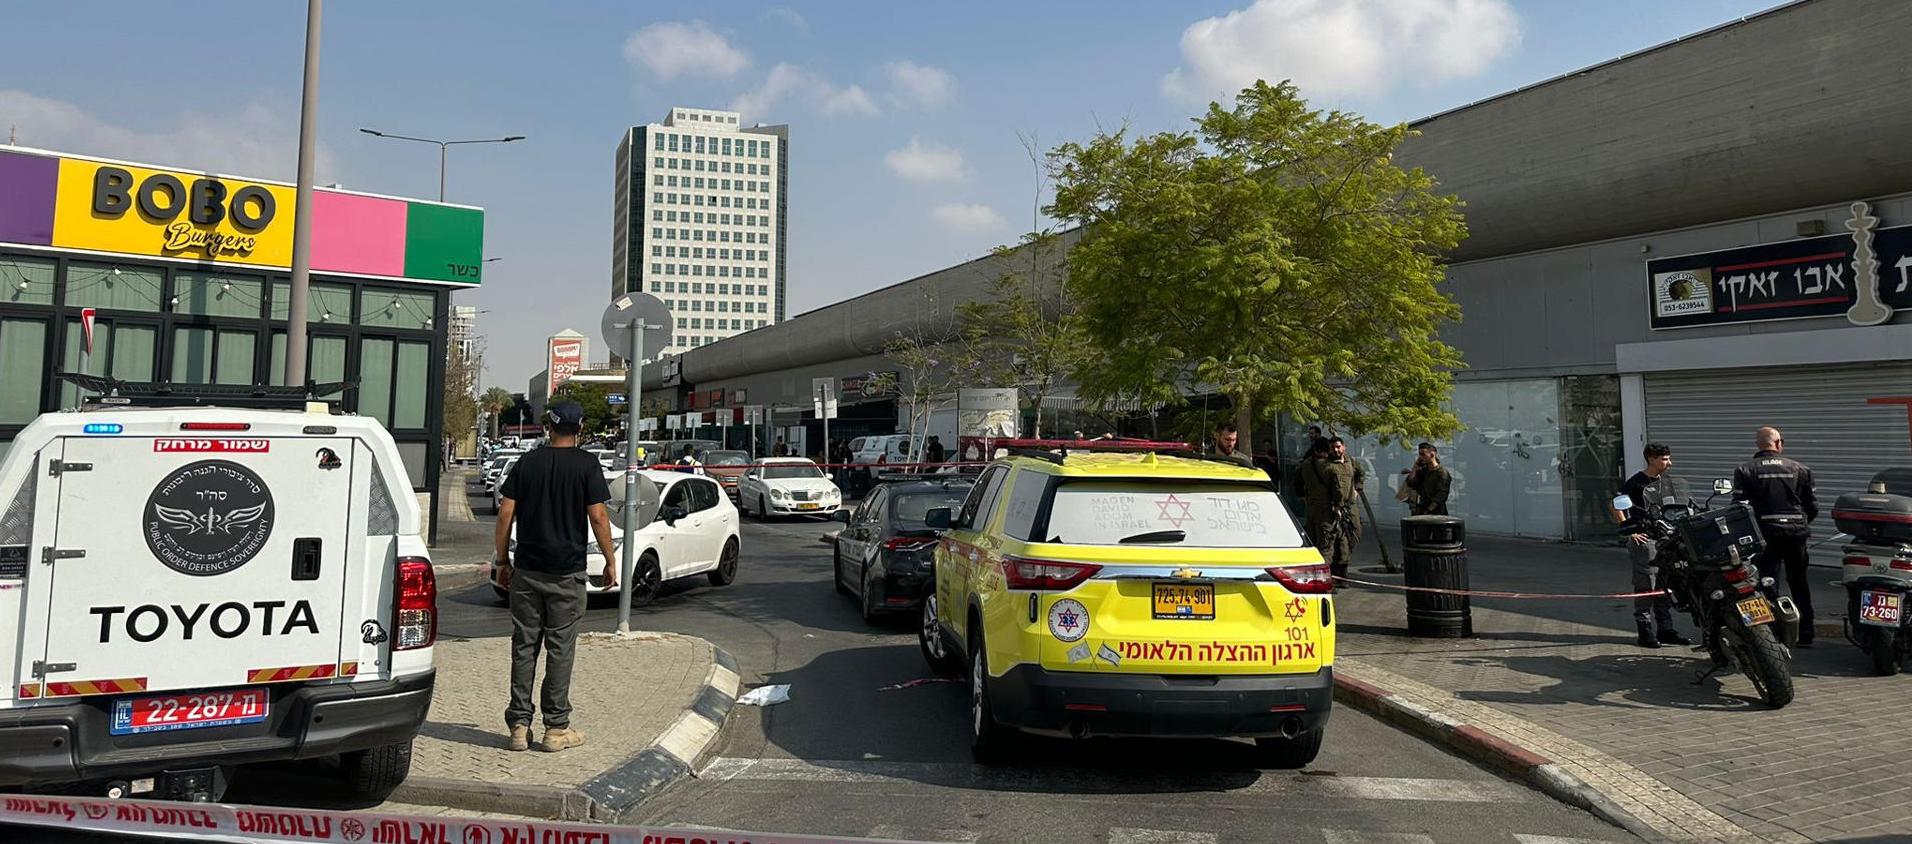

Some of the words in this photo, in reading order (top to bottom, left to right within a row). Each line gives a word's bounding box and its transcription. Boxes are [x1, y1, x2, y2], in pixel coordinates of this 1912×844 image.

[93, 166, 276, 231] BOBO
[166, 222, 256, 257] Burgers
[447, 262, 480, 278] כשר
[1793, 262, 1846, 295] אבו
[1718, 270, 1779, 313] זאקי
[156, 440, 213, 451] מרחק
[218, 439, 267, 450] שמור
[193, 465, 217, 477] הגנה
[218, 467, 245, 481] ציבורי
[246, 478, 261, 494] סדר
[1110, 519, 1152, 529] ISRAEL
[150, 521, 166, 550] PUBLIC
[162, 547, 190, 569] ORDER
[188, 560, 229, 572] DEFENCE
[229, 518, 269, 566] SOVEREIGNTY
[89, 599, 320, 644] TOYOTA
[1863, 606, 1898, 619] 73-260
[1285, 627, 1309, 641] 101
[1119, 640, 1193, 661] הלאומי
[1199, 641, 1267, 662] ההצלה
[1272, 642, 1316, 665] ארגון
[236, 810, 332, 839] משטרת
